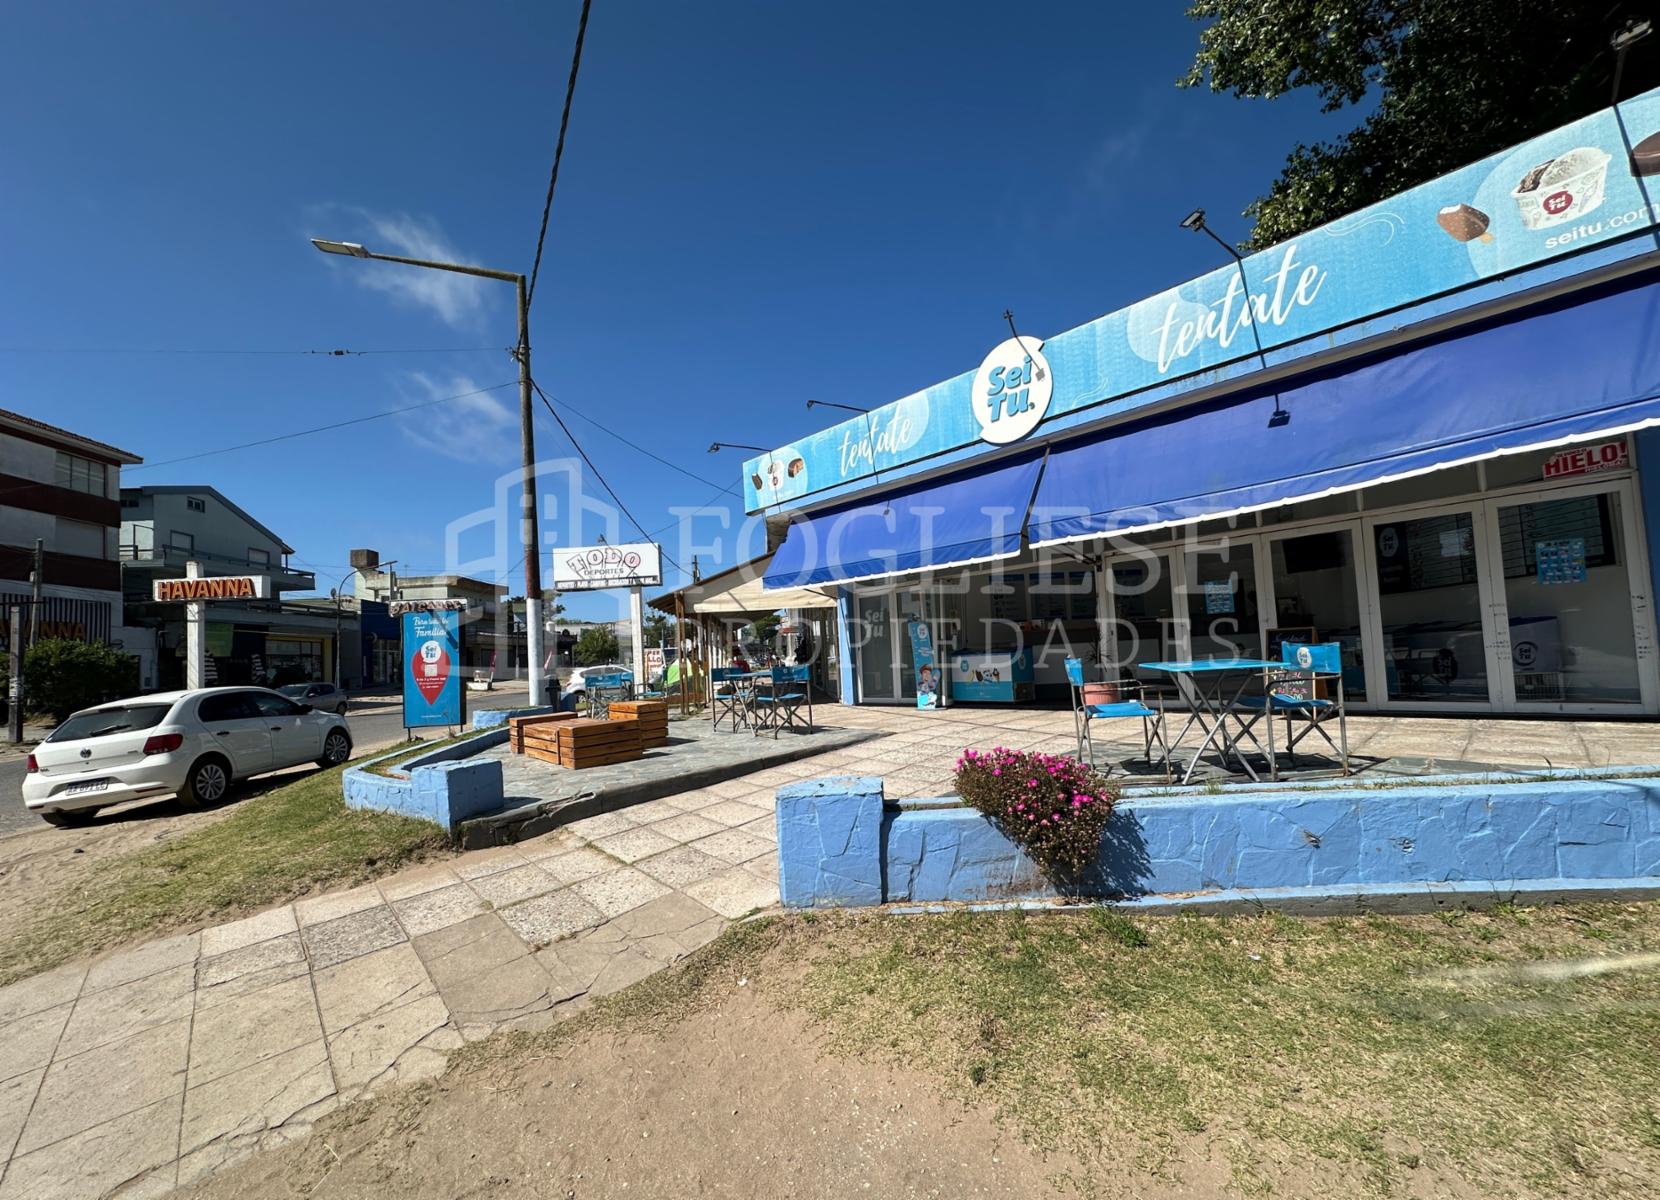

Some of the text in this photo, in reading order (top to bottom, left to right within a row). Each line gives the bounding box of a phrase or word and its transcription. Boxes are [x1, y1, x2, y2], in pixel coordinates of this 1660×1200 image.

[1150, 244, 1327, 373] tentate
[987, 355, 1032, 396] Sei
[839, 402, 913, 477] tentate
[1544, 441, 1628, 475] HIELO!
[157, 578, 256, 599] HAVANNA
[584, 567, 625, 577] DEPORTES
[865, 608, 885, 622] Sei
